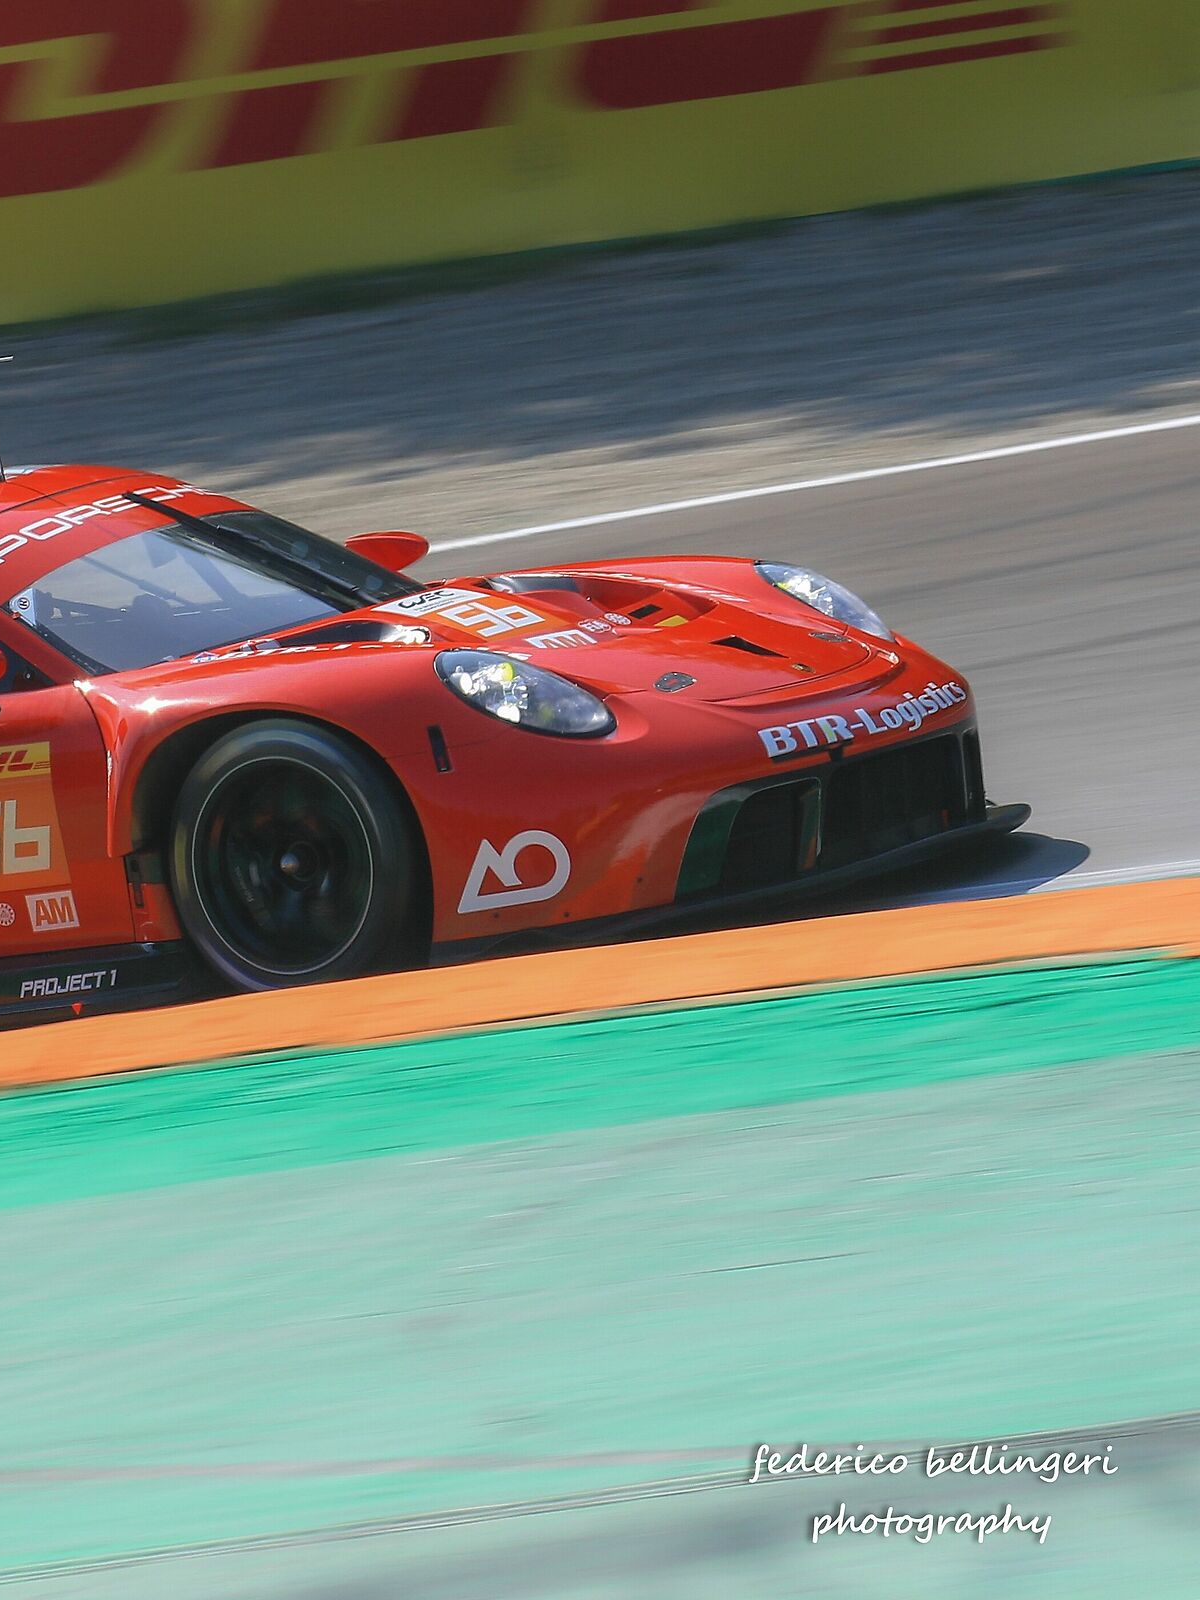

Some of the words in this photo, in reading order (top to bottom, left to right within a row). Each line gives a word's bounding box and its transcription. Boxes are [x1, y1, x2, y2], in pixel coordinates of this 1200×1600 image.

[436, 602, 546, 637] 56
[758, 682, 967, 758] BTR-Logistics
[35, 897, 75, 926] AM
[20, 971, 106, 998] PROJECT
[108, 969, 118, 986] 1
